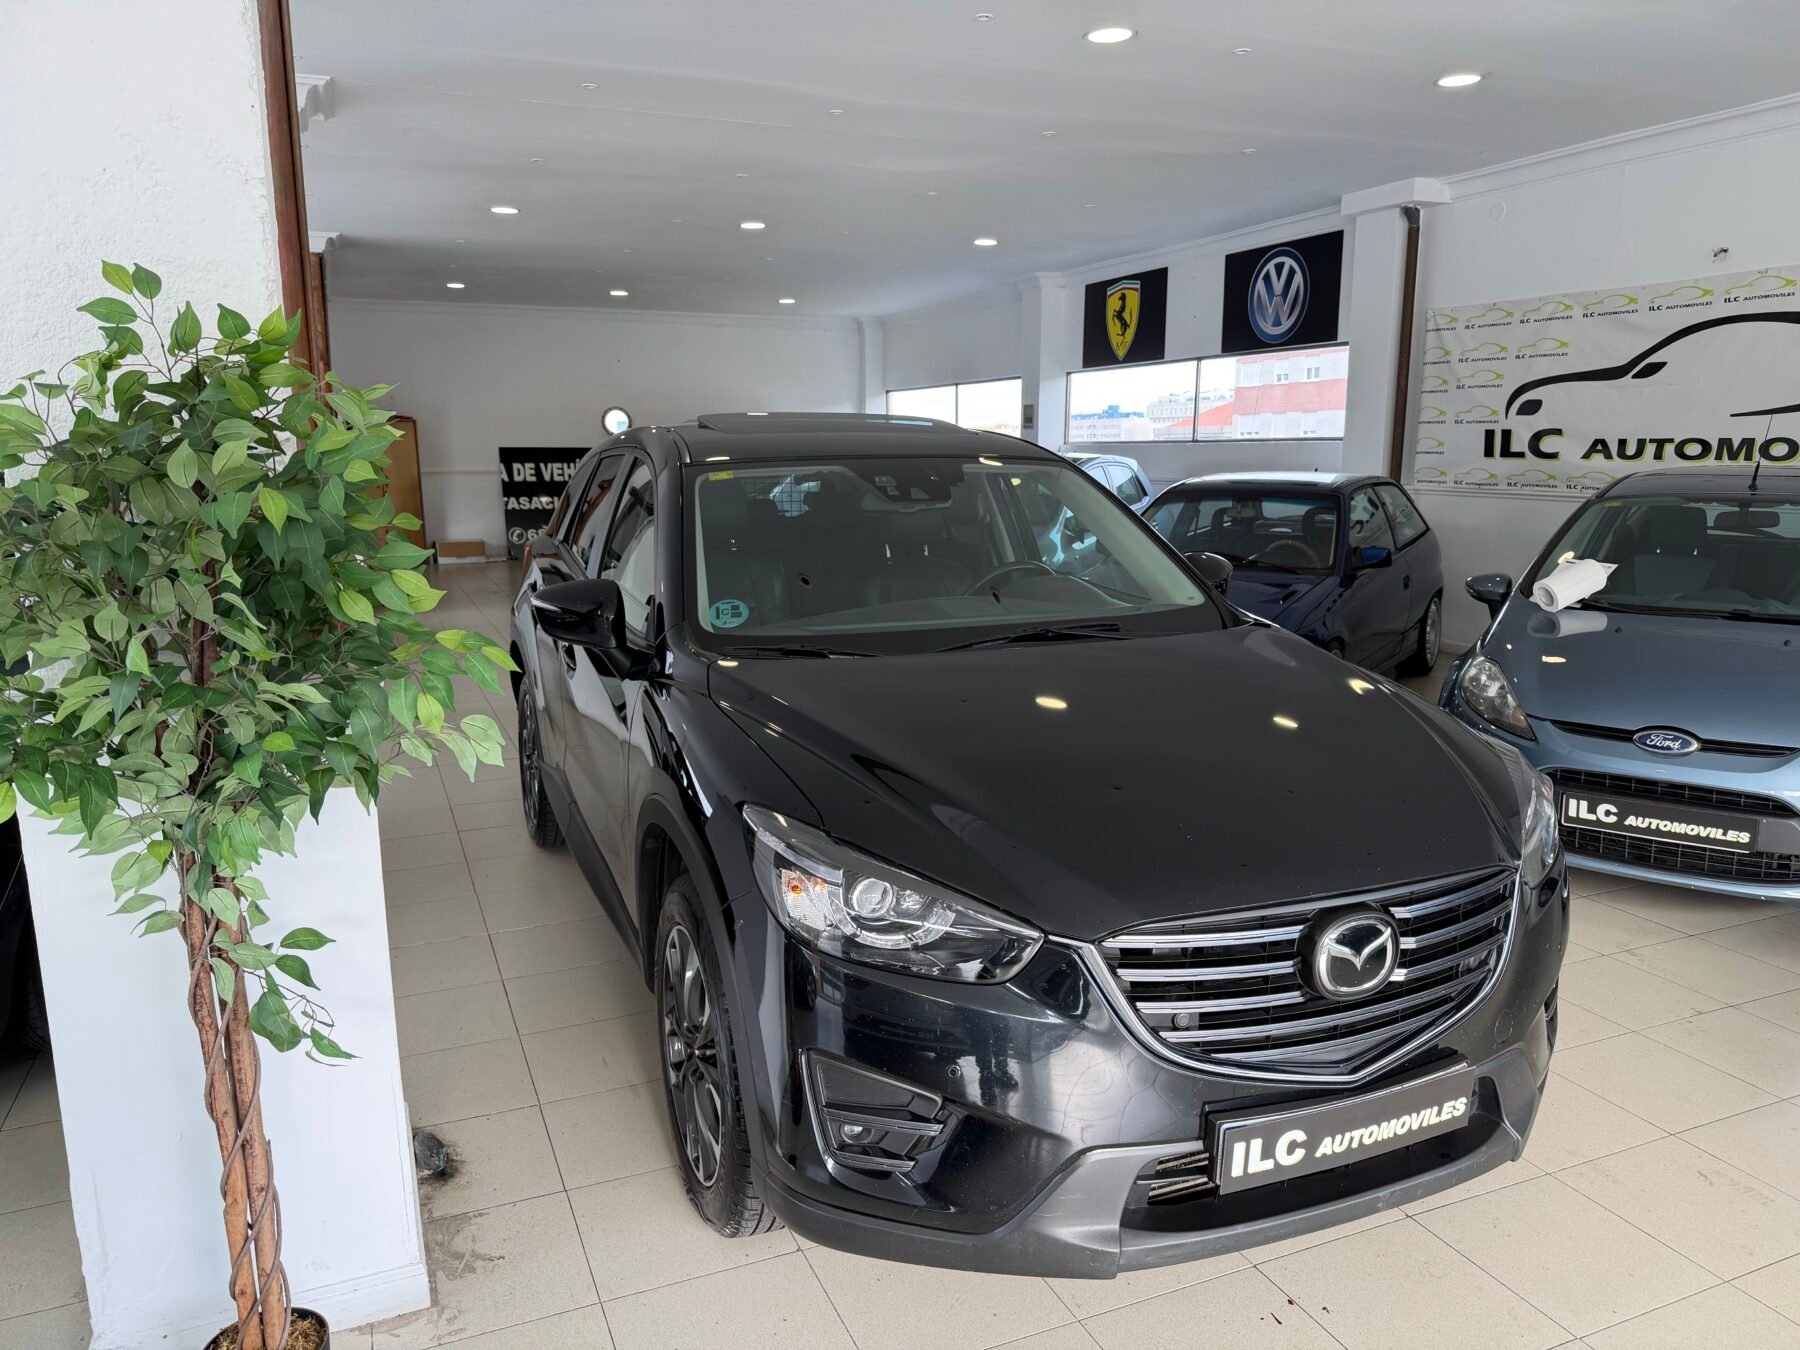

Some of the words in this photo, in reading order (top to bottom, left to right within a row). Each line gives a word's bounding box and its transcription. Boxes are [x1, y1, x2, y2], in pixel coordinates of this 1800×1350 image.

[1743, 292, 1796, 301] AUTOMOVILES
[1597, 308, 1639, 317] AUTOMOVILES
[1665, 301, 1713, 310] AUTOMOVILES
[1533, 315, 1573, 323] AUTOMOVILES
[1484, 428, 1563, 460] ILC
[1580, 437, 1800, 464] AUTOMO
[512, 463, 537, 482] DE
[1647, 733, 1682, 750] Ford
[1568, 798, 1618, 823] ILC
[1624, 815, 1751, 843] AUTOMOVILES
[1231, 1130, 1307, 1178] ILC
[1315, 1097, 1467, 1157] AUTOMOVILES
